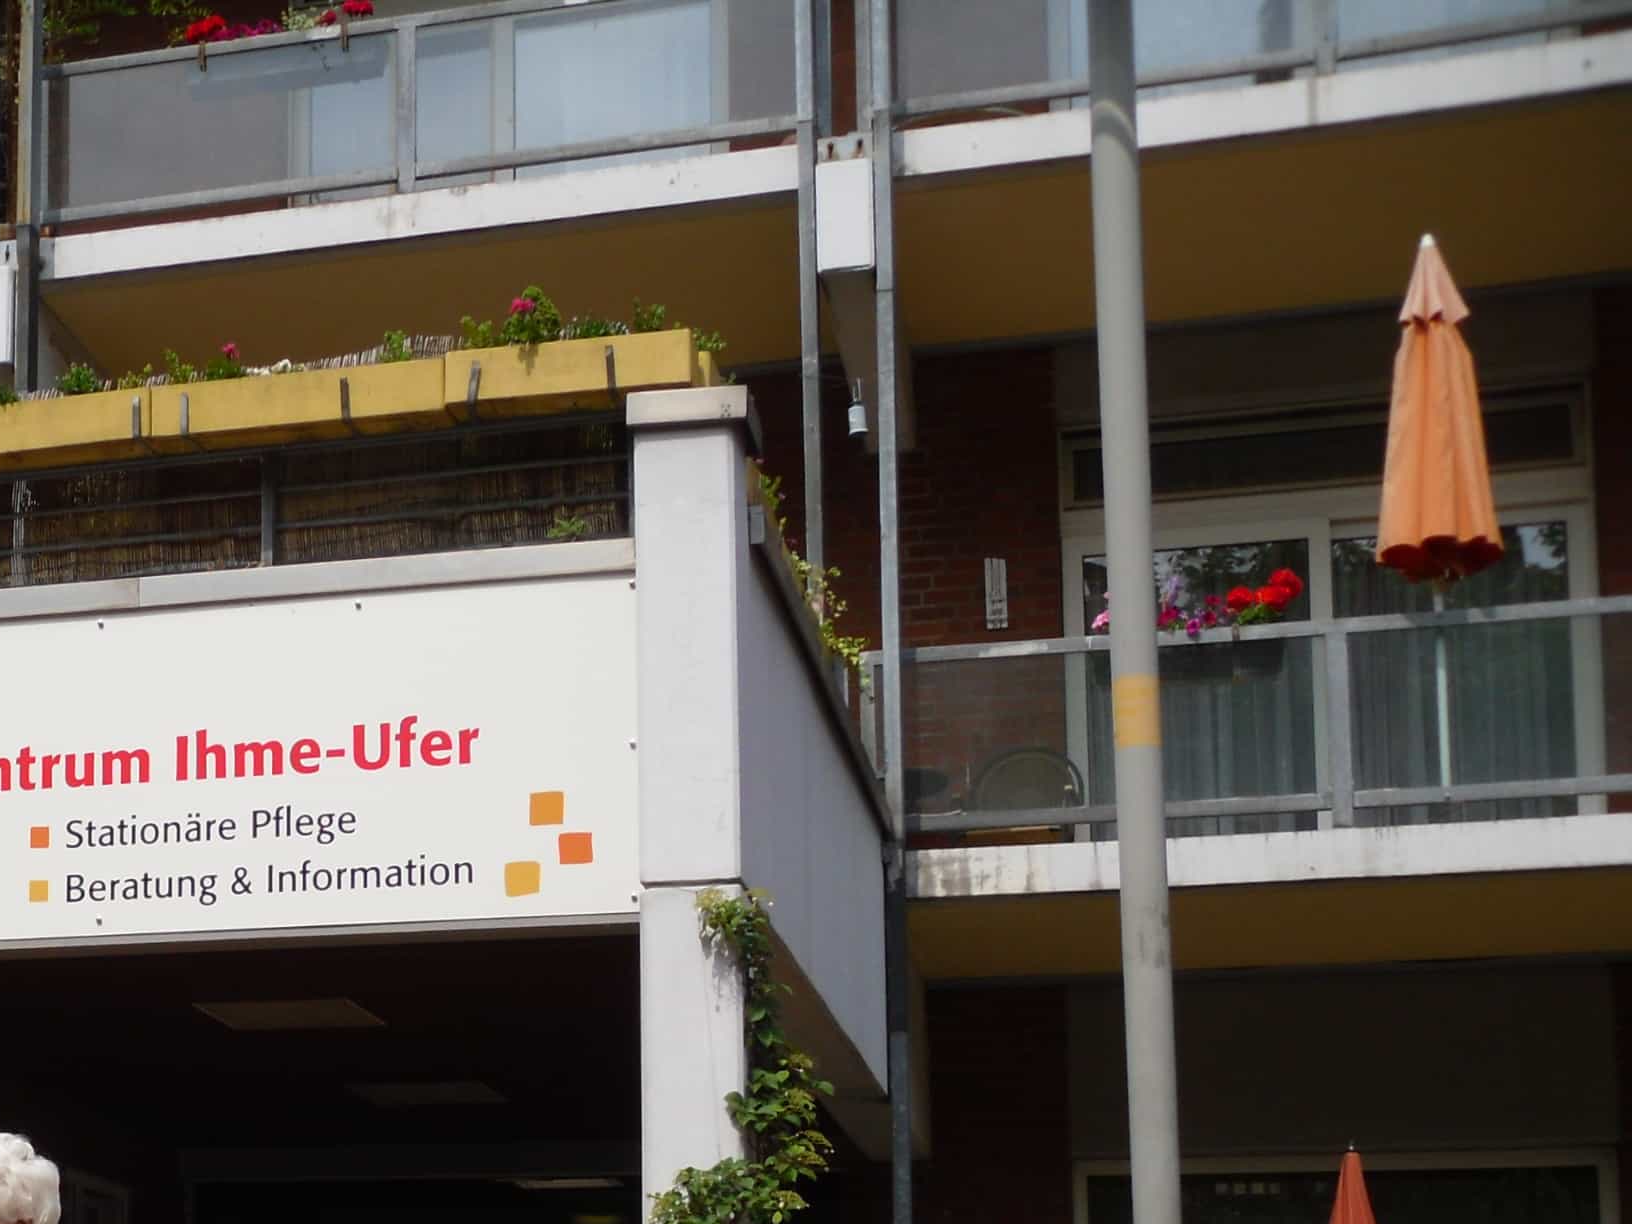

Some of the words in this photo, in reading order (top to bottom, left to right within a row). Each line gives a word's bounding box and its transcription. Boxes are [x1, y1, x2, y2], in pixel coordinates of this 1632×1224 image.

[176, 715, 480, 782] Ihme-Ufer
[66, 812, 237, 849] Stationäre
[252, 804, 357, 845] Pflege
[67, 872, 218, 906] Beratung
[231, 866, 253, 895] &
[267, 854, 473, 893] Information
